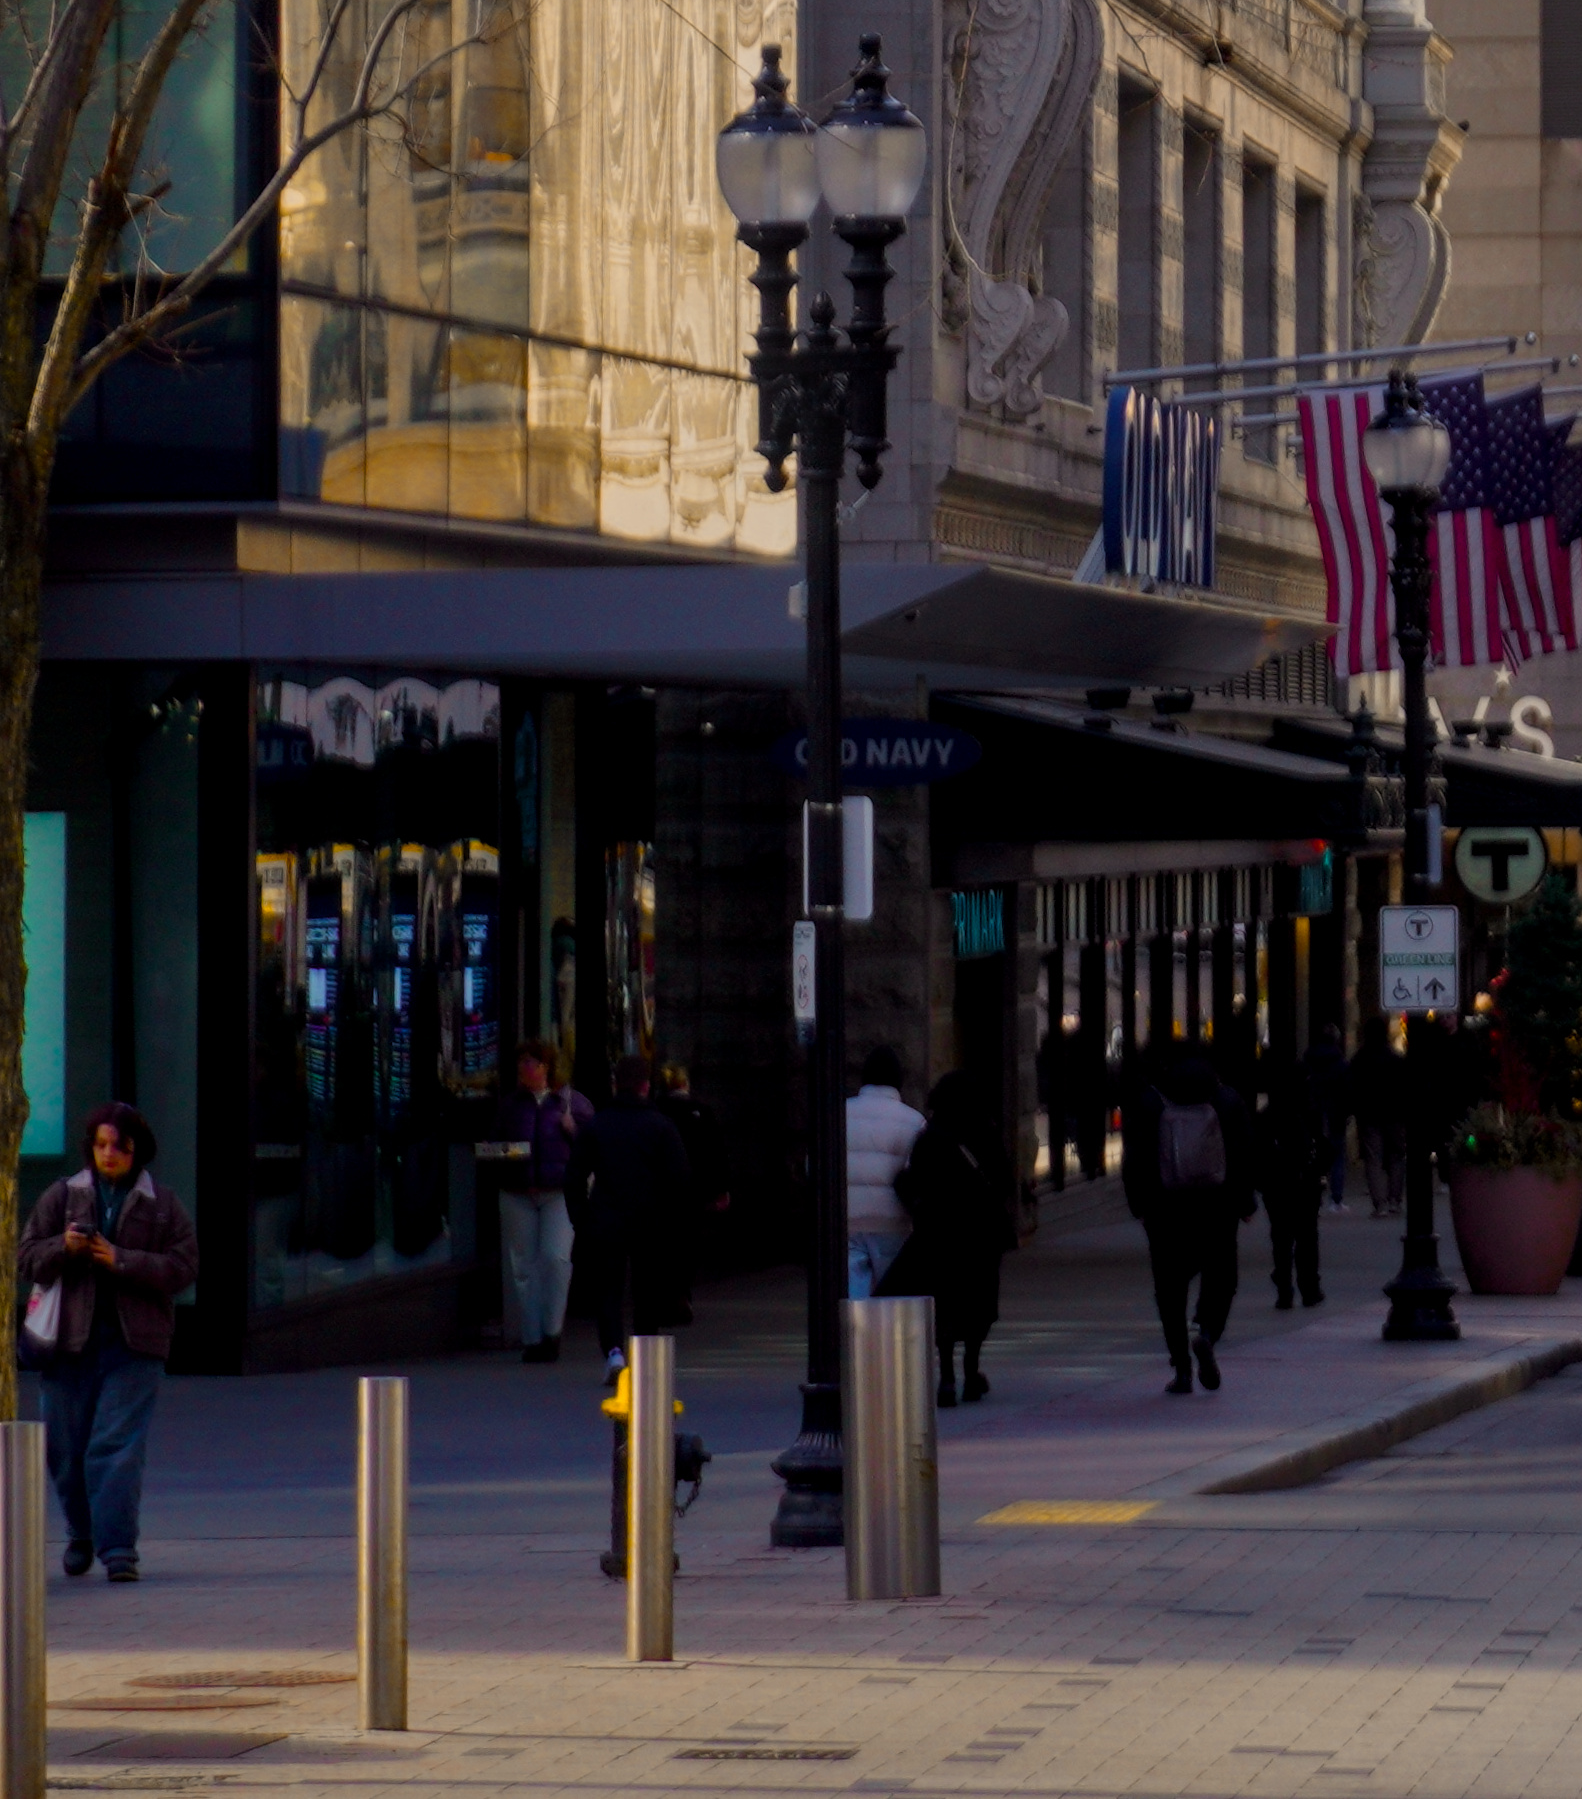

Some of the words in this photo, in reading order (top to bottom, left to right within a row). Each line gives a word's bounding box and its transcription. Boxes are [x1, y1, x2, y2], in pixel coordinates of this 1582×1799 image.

[794, 738, 859, 766] OD
[866, 737, 955, 767] NAVY
[1471, 838, 1530, 892] T
[1410, 919, 1429, 936] T
